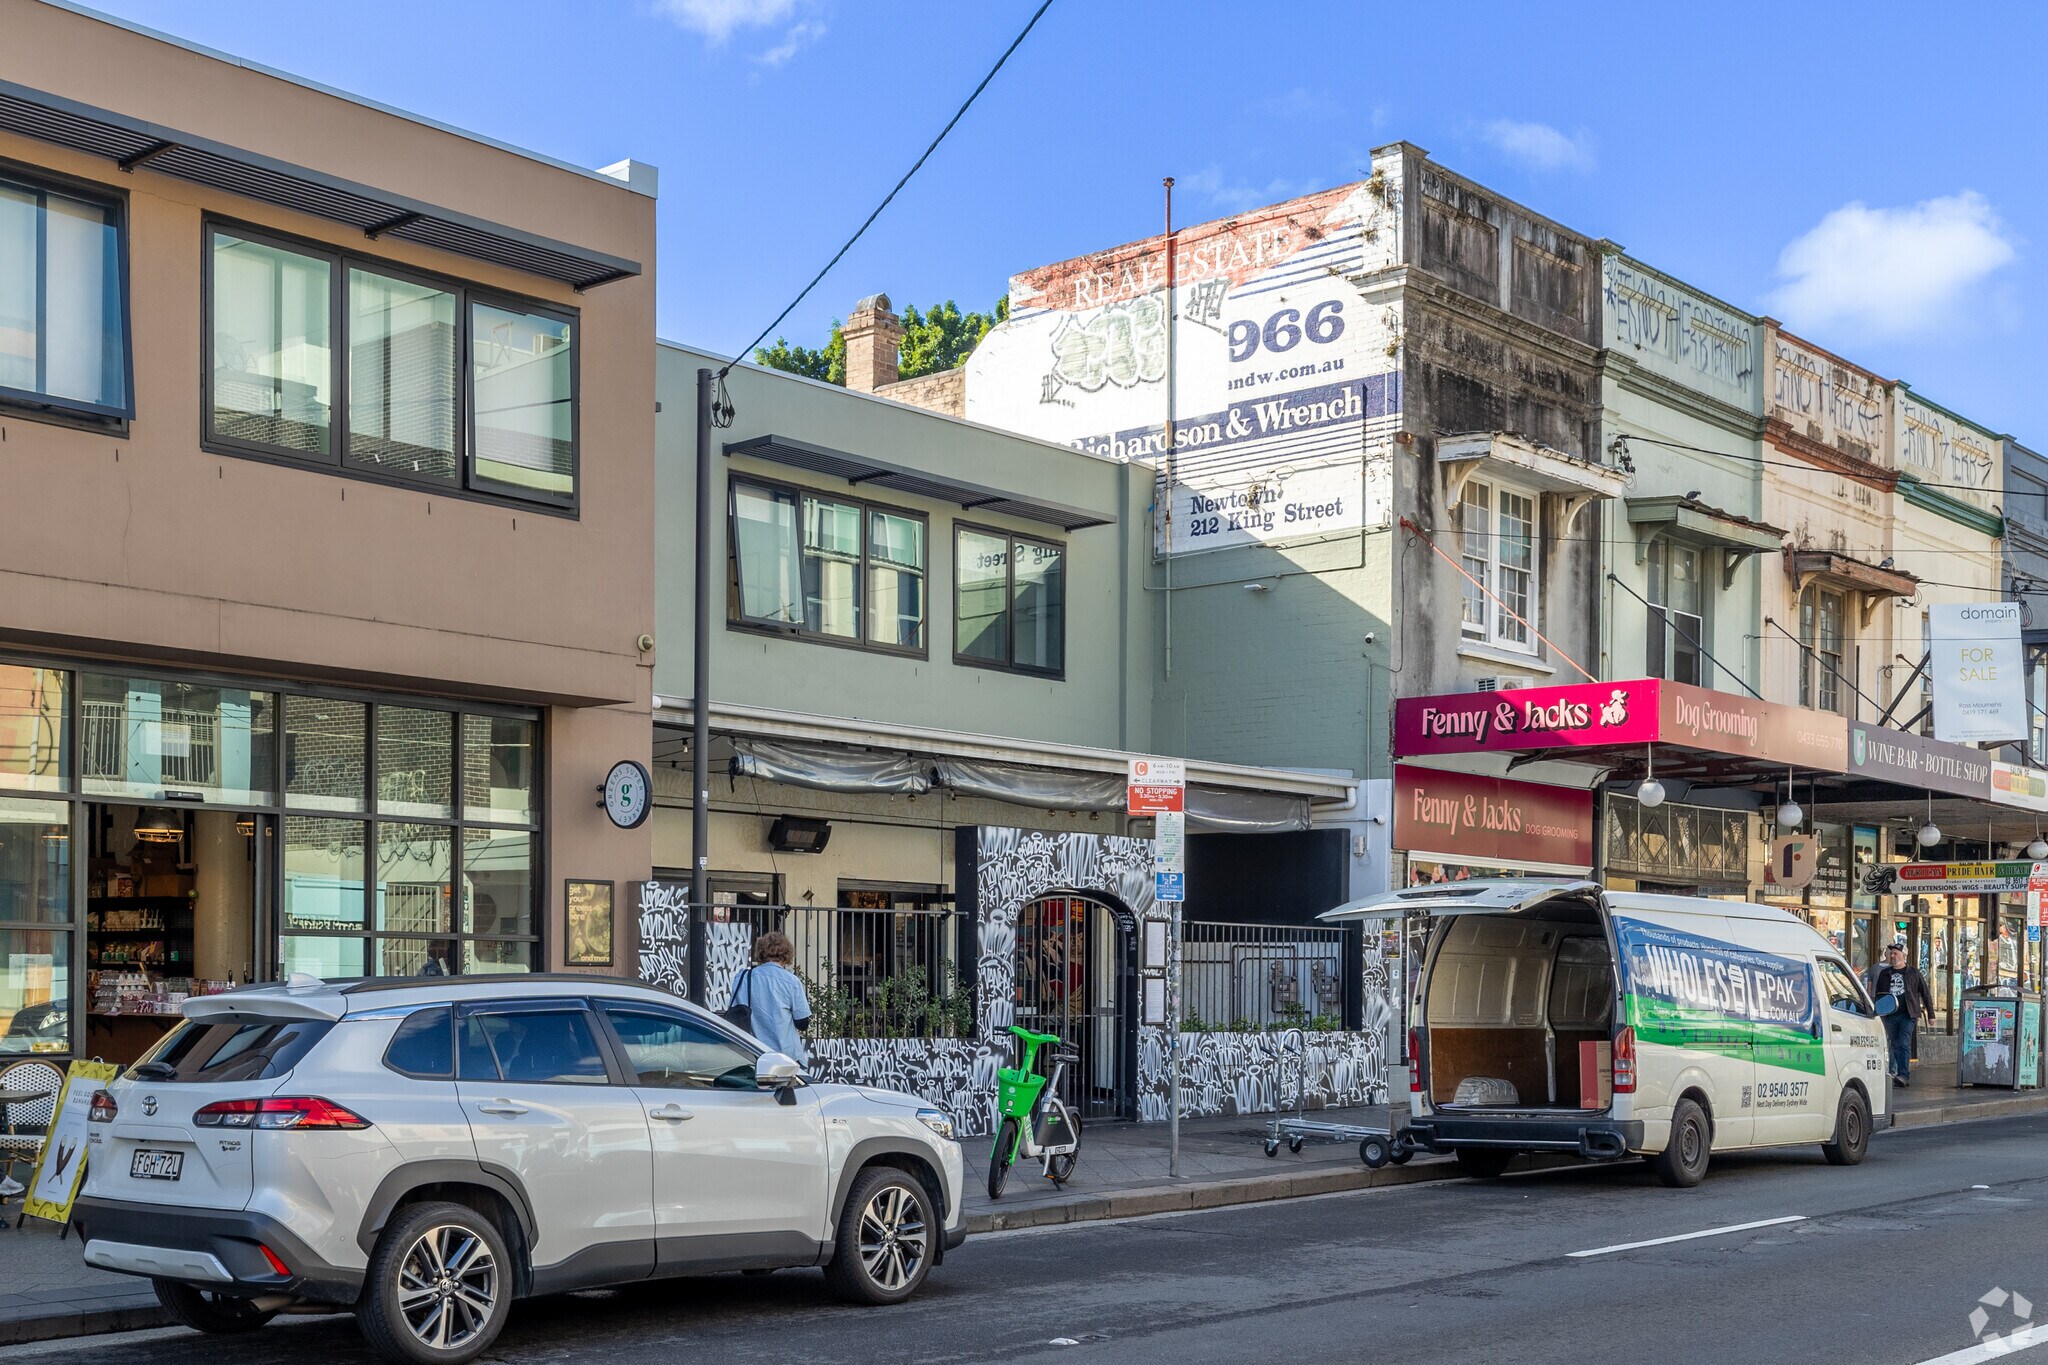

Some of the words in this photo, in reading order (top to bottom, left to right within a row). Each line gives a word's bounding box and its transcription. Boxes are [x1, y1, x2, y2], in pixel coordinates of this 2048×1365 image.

[1074, 261, 1161, 307] REAL
[1173, 225, 1293, 281] ESTATE
[1228, 299, 1347, 364] 966
[1225, 407, 1253, 439] &
[1252, 385, 1363, 433] Wrench
[1190, 486, 1277, 515] Newtown
[1190, 519, 1220, 537] 212
[1227, 510, 1275, 532] King
[1284, 497, 1344, 523] Street
[1960, 606, 2017, 620] domain
[1961, 648, 1994, 663] FOR
[1960, 666, 1997, 682] SALE
[1422, 707, 1488, 742] Fenny
[1493, 702, 1518, 733] &
[1521, 698, 1591, 731] Jacks
[1676, 695, 1700, 737] Dog
[1702, 701, 1758, 747] Grooming
[1868, 740, 1896, 765] WINE
[1897, 747, 1918, 770] BAR
[1925, 753, 1962, 779] BOTTLE
[1963, 761, 1988, 783] SHOP
[608, 769, 623, 808] GREENS
[626, 767, 644, 791] SUPER
[1146, 787, 1178, 795] STOPPING
[618, 798, 643, 823] MARKET
[1413, 788, 1458, 835] Fenny
[1462, 794, 1477, 828] &
[1480, 797, 1522, 832] Jacks
[1525, 823, 1541, 835] DOG
[1542, 825, 1579, 840] GROOMING
[1947, 866, 1972, 877] PRIDE
[1974, 865, 1995, 876] HAIR
[569, 885, 582, 896] get
[1901, 884, 1918, 892] HAIR
[1918, 884, 1957, 892] EXTENSIONS
[1983, 883, 2010, 891] BEAUTY
[569, 896, 584, 905] your
[569, 904, 592, 914] greens
[1640, 927, 1670, 943] Thousands
[1670, 935, 1677, 944] of
[1724, 949, 1730, 957] of
[1757, 1083, 1768, 1098] 02
[1769, 1082, 1788, 1098] 9540
[1789, 1081, 1809, 1097] 3577
[1764, 1100, 1772, 1109] Day
[1772, 1099, 1786, 1108] Delivery
[1786, 1099, 1799, 1108] Sydney
